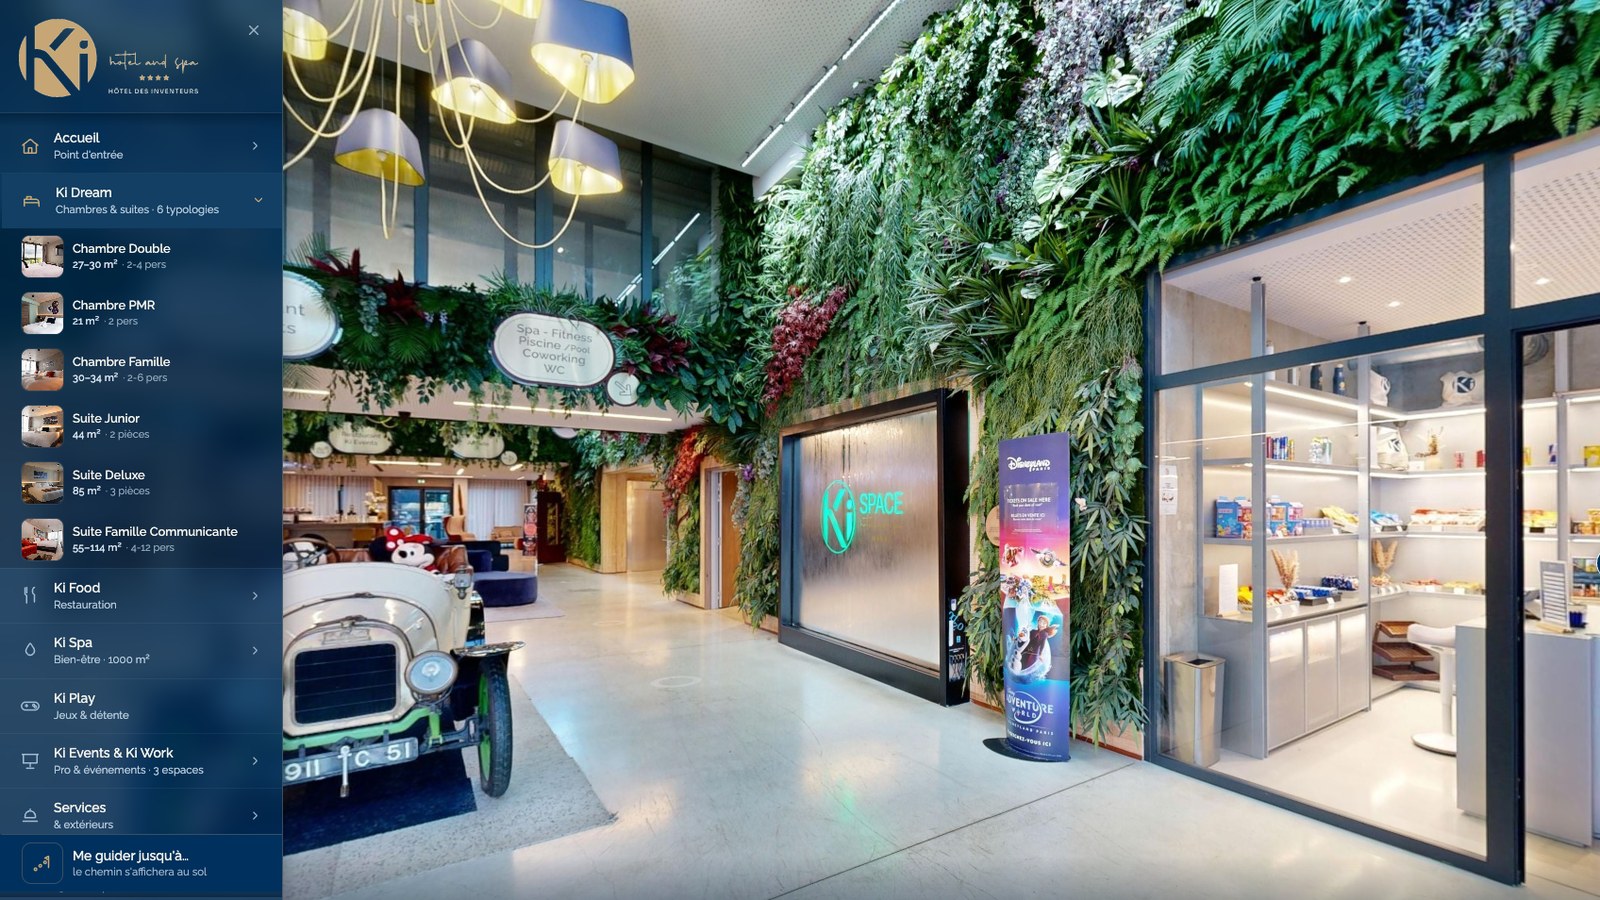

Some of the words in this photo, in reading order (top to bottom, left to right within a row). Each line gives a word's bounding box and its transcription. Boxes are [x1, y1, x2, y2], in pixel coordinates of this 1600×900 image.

[516, 323, 540, 336] Spa
[552, 328, 593, 343] Fitness
[519, 336, 561, 350] Piscine
[564, 344, 590, 354] /Pool
[522, 348, 586, 367] Coworking
[544, 363, 565, 375] WC
[821, 483, 855, 552] Ki
[859, 490, 905, 515] SPACE
[1006, 693, 1054, 714] DVENTURE
[1011, 707, 1037, 719] WRLD
[284, 759, 320, 781] 911
[354, 750, 370, 767] C
[387, 741, 411, 761] 51
